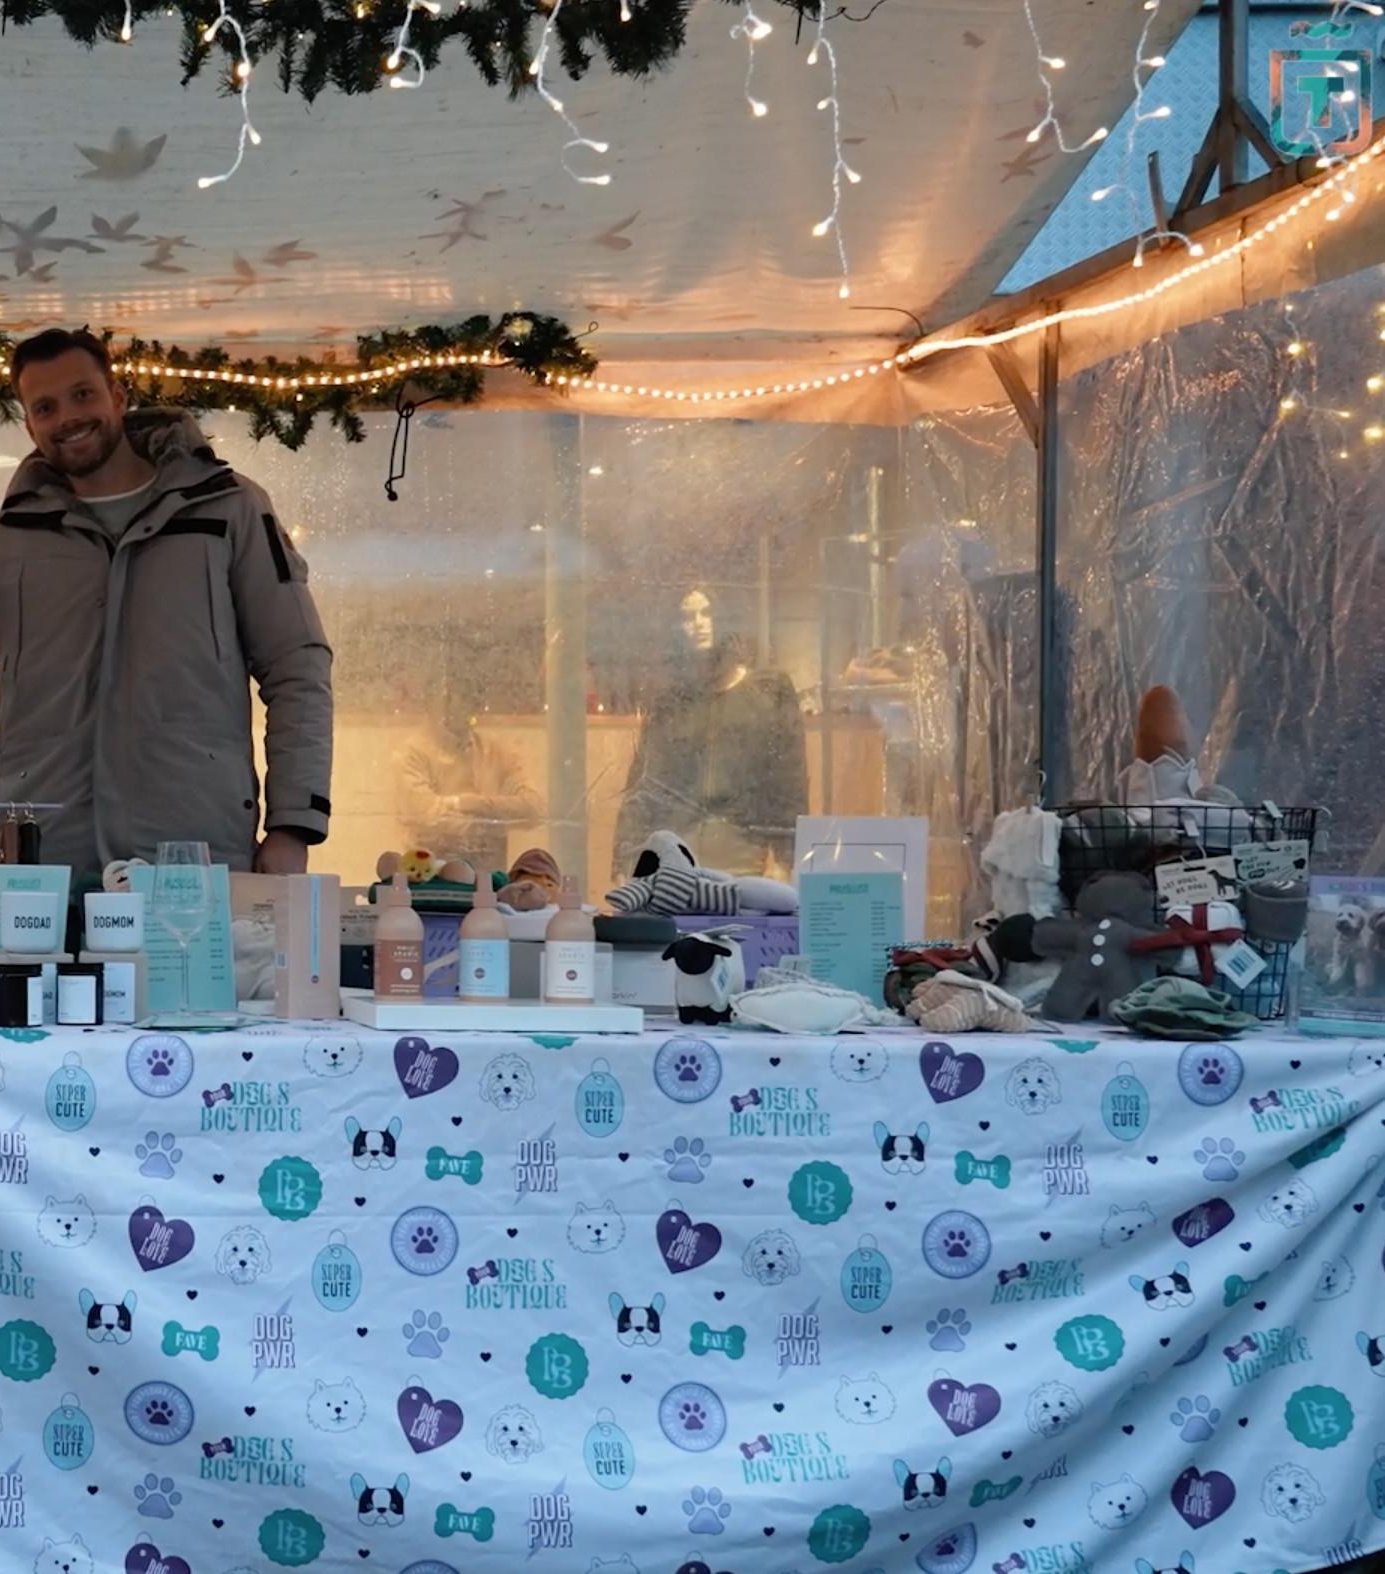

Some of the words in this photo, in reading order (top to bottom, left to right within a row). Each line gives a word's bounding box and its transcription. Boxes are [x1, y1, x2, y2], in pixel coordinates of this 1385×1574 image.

[93, 916, 135, 928] DOGMOM
[54, 1100, 86, 1118] CUTE
[199, 1105, 302, 1133] BOUTIQUE
[584, 1106, 614, 1122] CUTE
[1111, 1111, 1142, 1128] CUTE
[728, 1110, 831, 1137] BOUTIQUE
[516, 1140, 556, 1166] DOG
[1045, 1144, 1084, 1171] DOG
[439, 1158, 471, 1175] FAVE
[515, 1164, 558, 1192] PWR
[966, 1161, 1000, 1179] FAVE
[1044, 1169, 1089, 1196] PWR
[321, 1279, 352, 1297] CUTE
[466, 1284, 567, 1310] BOUTIQUE
[850, 1279, 883, 1299] CUTE
[254, 1314, 293, 1341] DOG
[778, 1313, 818, 1340] DOG
[175, 1333, 207, 1350] FAVE
[702, 1332, 734, 1349] FAVE
[776, 1339, 821, 1366] PWR
[251, 1340, 296, 1368] PWR
[53, 1438, 84, 1456] CUTE
[199, 1457, 306, 1489] BOUTIQUE
[593, 1458, 626, 1476] CUTE
[741, 1452, 850, 1484] BOUTIQUE
[528, 1495, 569, 1520] DOG
[448, 1515, 480, 1531] FAVE
[527, 1519, 573, 1548] PWR
